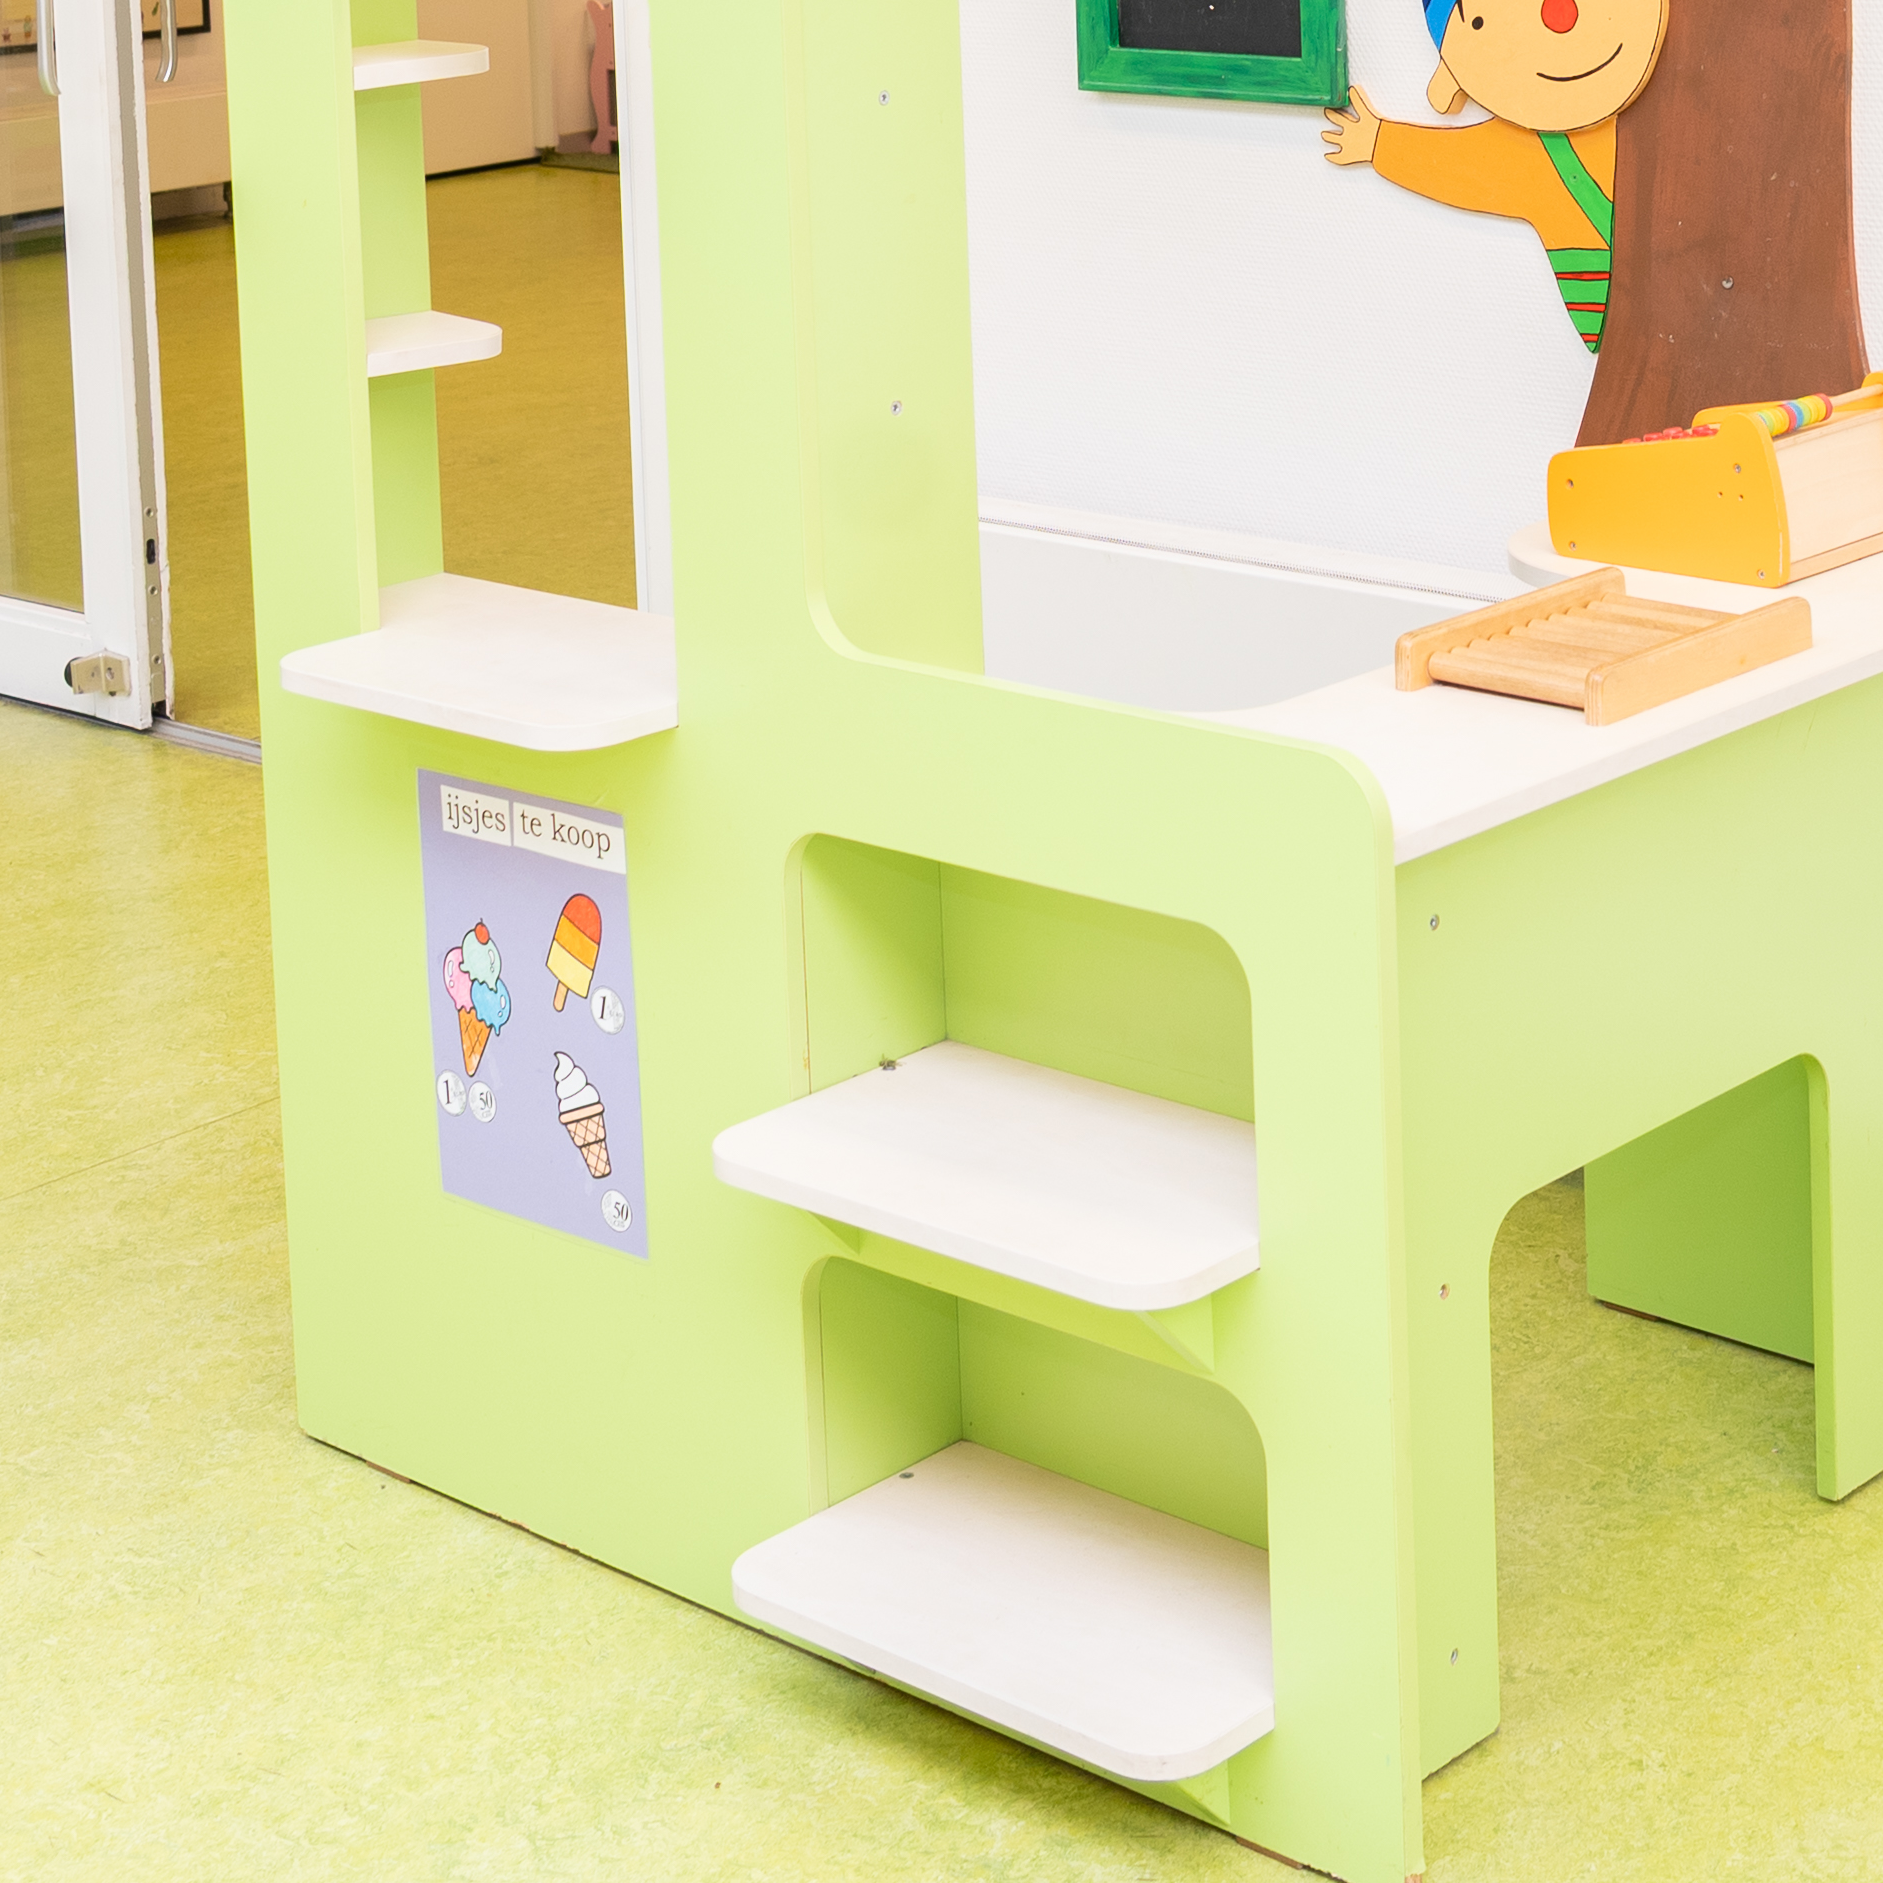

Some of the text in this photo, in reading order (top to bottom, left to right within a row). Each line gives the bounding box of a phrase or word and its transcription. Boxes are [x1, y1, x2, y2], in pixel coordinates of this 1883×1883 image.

[446, 793, 611, 860] ijsjes te koop
[598, 995, 607, 1020] 1
[443, 1079, 493, 1110] 1 50
[613, 1201, 629, 1221] 50
